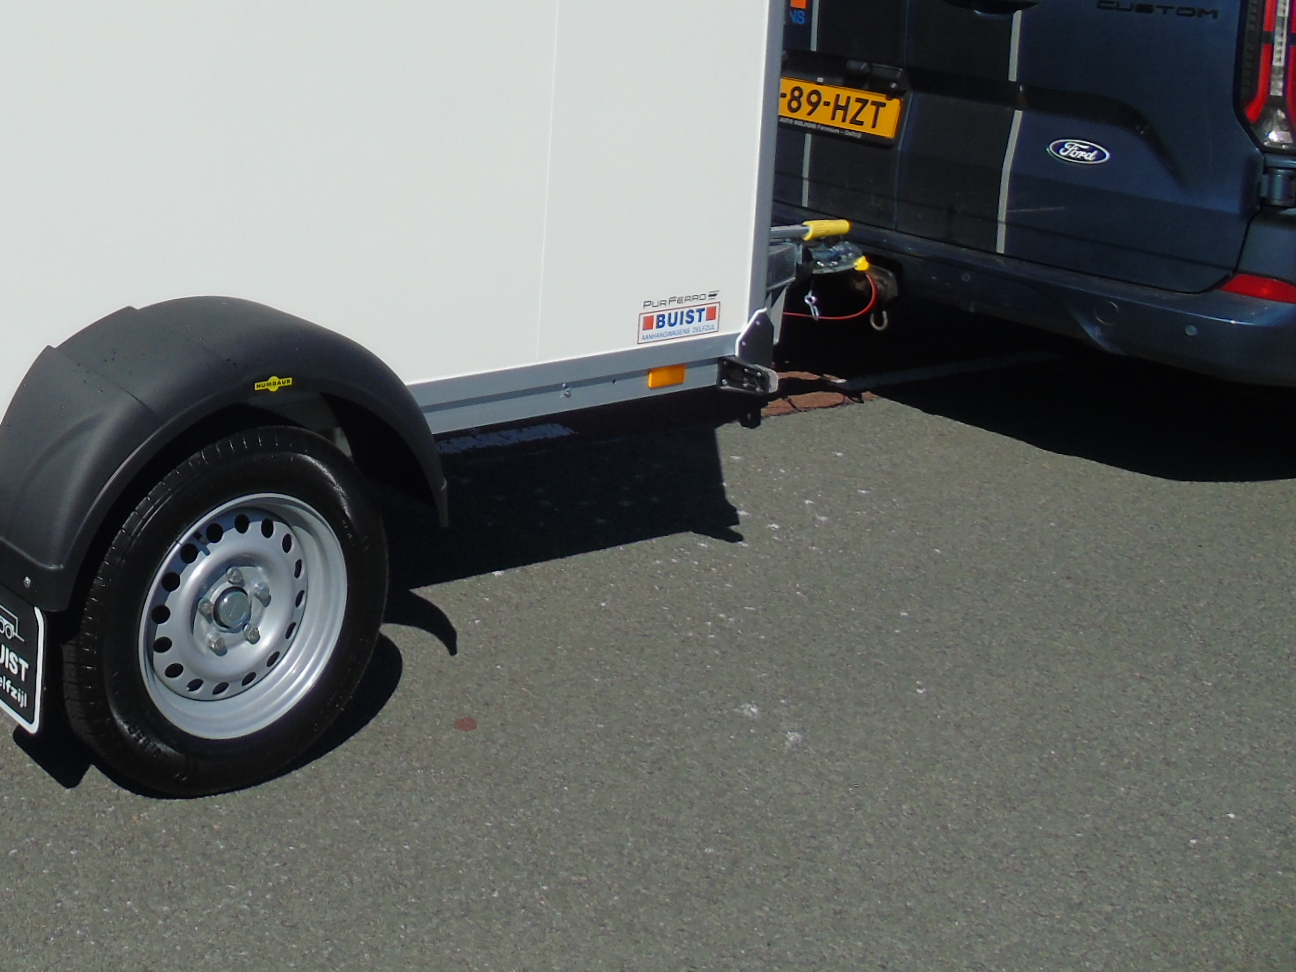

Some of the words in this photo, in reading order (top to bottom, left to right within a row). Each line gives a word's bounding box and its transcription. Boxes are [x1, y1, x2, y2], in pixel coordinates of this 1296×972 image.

[1096, 0, 1219, 19] CUSTOM
[1059, 140, 1097, 162] Ford
[655, 308, 706, 329] BUIST
